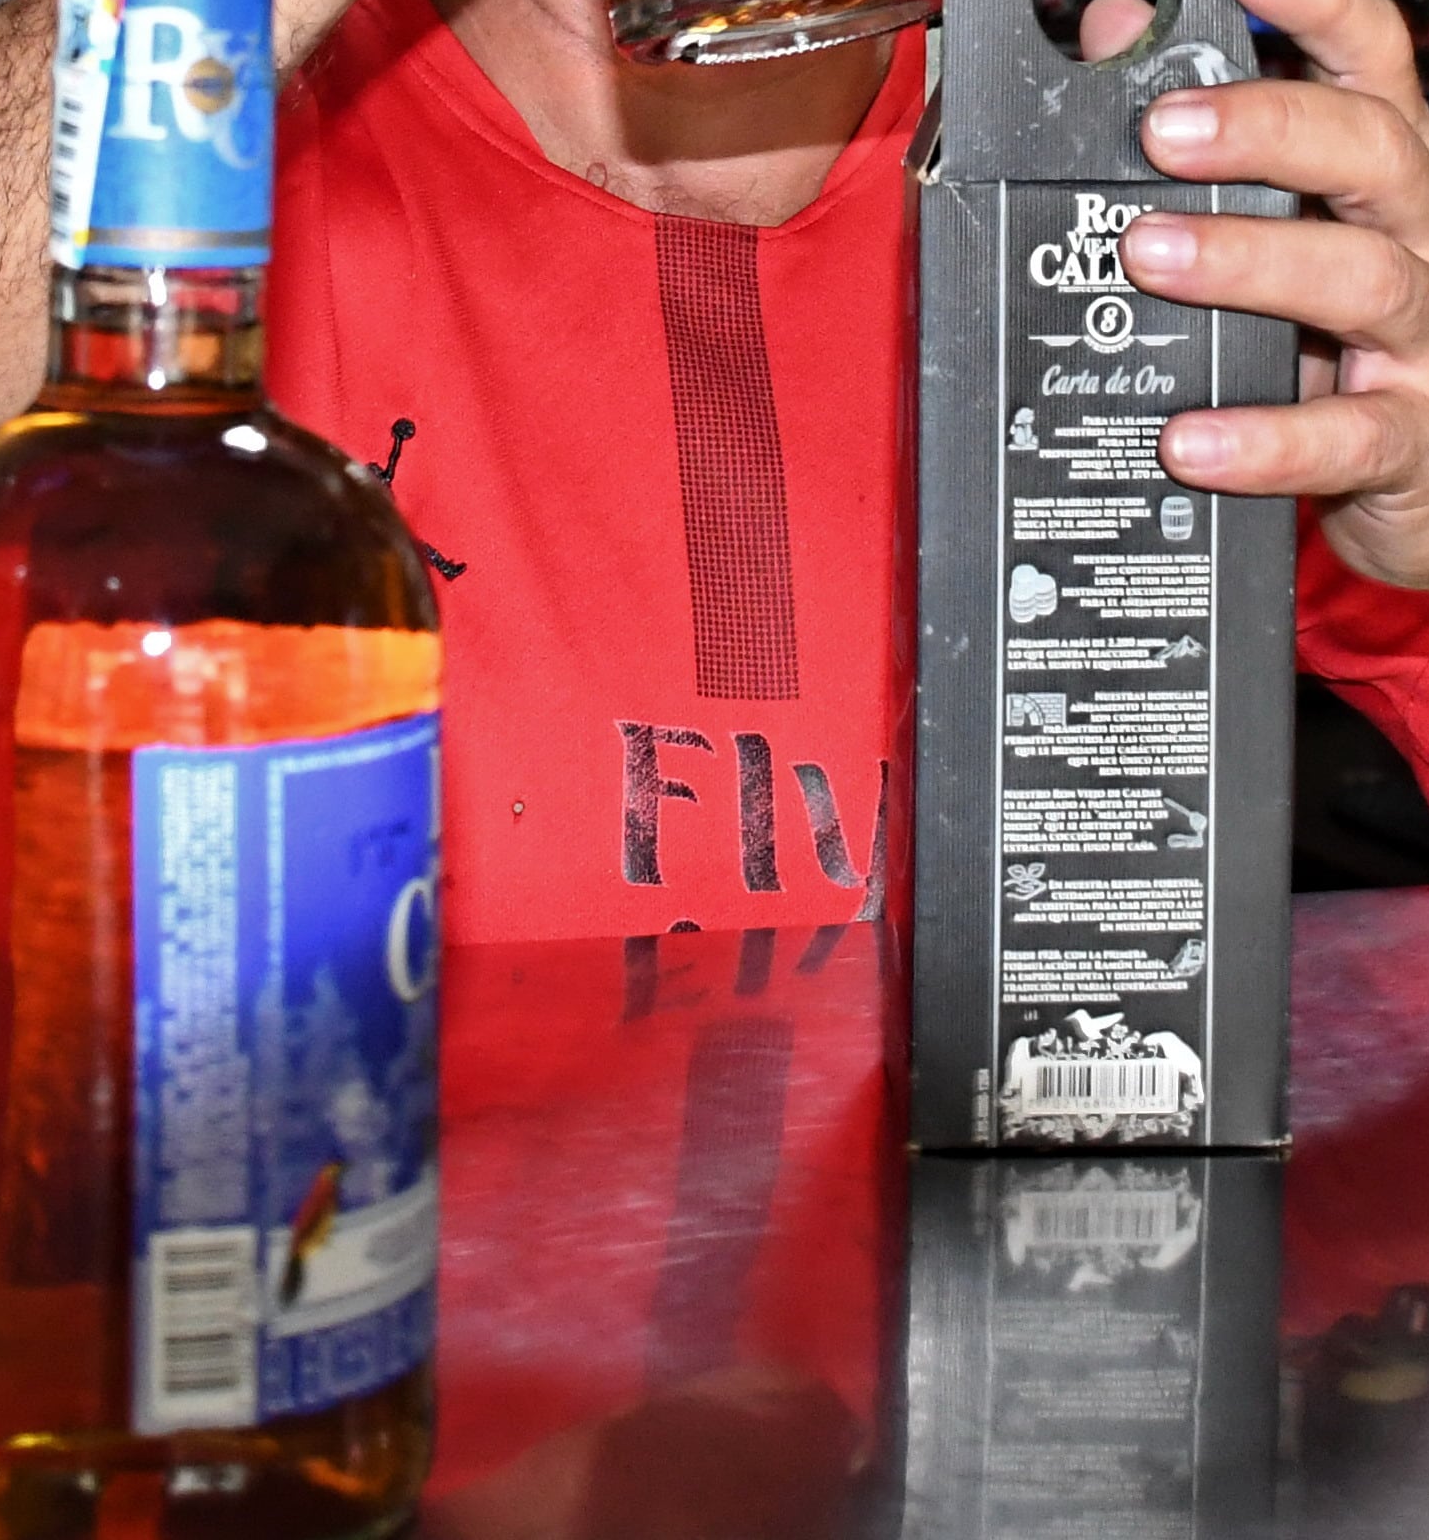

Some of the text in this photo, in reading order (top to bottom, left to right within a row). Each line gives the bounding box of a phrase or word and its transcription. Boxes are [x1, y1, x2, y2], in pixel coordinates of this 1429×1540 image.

[1099, 306, 1119, 334] 8
[1041, 365, 1176, 396] Carta de Oro
